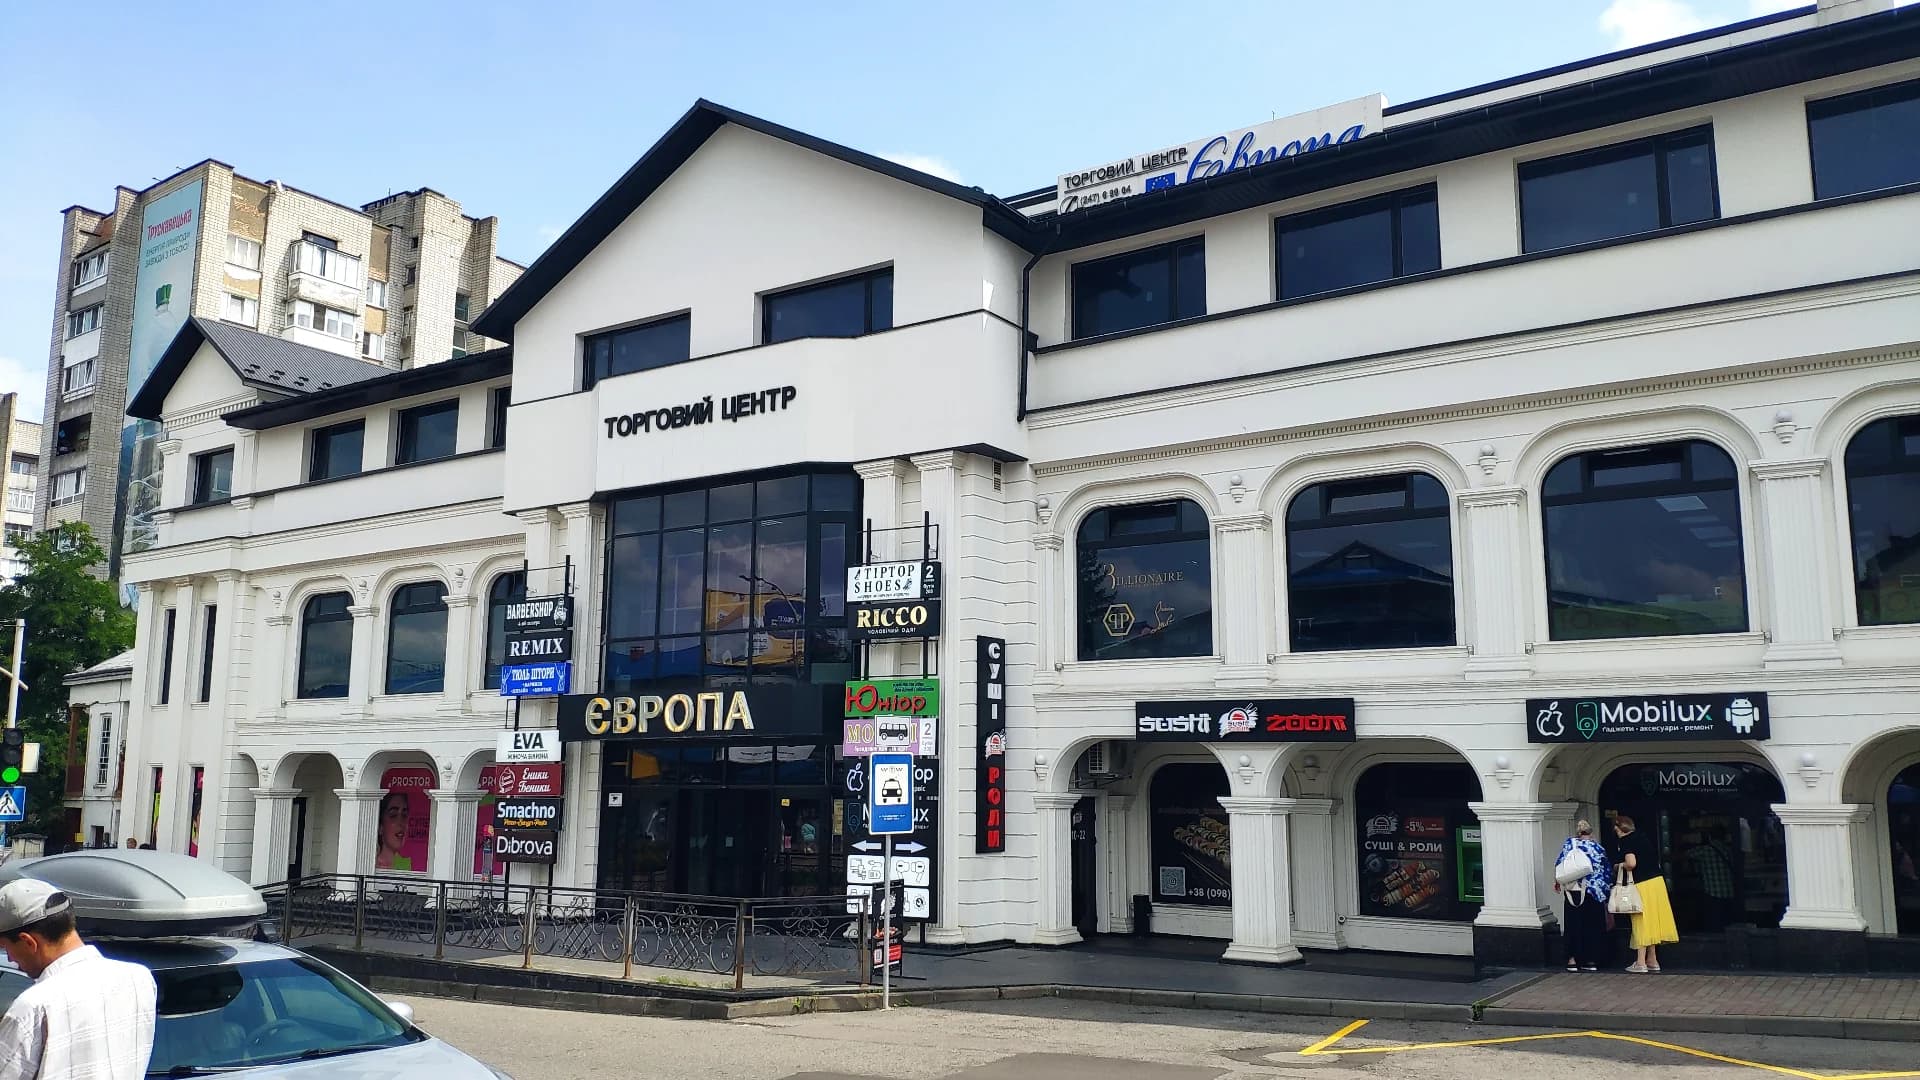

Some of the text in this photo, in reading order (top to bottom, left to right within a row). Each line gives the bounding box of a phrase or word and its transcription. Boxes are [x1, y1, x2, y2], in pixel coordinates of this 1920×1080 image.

[1064, 147, 1188, 188] ТОРГОВИЙ ЦЕНТР
[604, 385, 797, 439] ТОРГОВИЙ ЦЕНТР
[864, 564, 934, 580] TIPTOP 2
[854, 580, 901, 594] SHOES
[507, 601, 554, 620] BARBERSHOP
[856, 605, 928, 628] RICCO
[509, 637, 564, 657] REMIX
[511, 667, 555, 681] ТЮЛЬ ШТОРИ
[987, 642, 1002, 720] СУШІ
[845, 685, 927, 714] Юніор
[585, 690, 755, 735] ЄВРОПА
[1601, 700, 1713, 723] Mobilux
[924, 722, 932, 736] 2
[1640, 724, 1679, 733] аксесуари
[1684, 724, 1714, 733] ремонт
[513, 732, 544, 749] EVA
[392, 776, 431, 787] PROSTOR
[522, 768, 549, 780] Еники
[1659, 770, 1736, 786] Mobilux
[518, 781, 551, 792] Беники
[497, 802, 556, 819] Smachno
[987, 767, 1000, 848] РОЛИ
[496, 836, 553, 855] Dibrova
[1364, 841, 1443, 852] СУШІ & РОЛИ
[1188, 888, 1231, 899] +38 (098)
